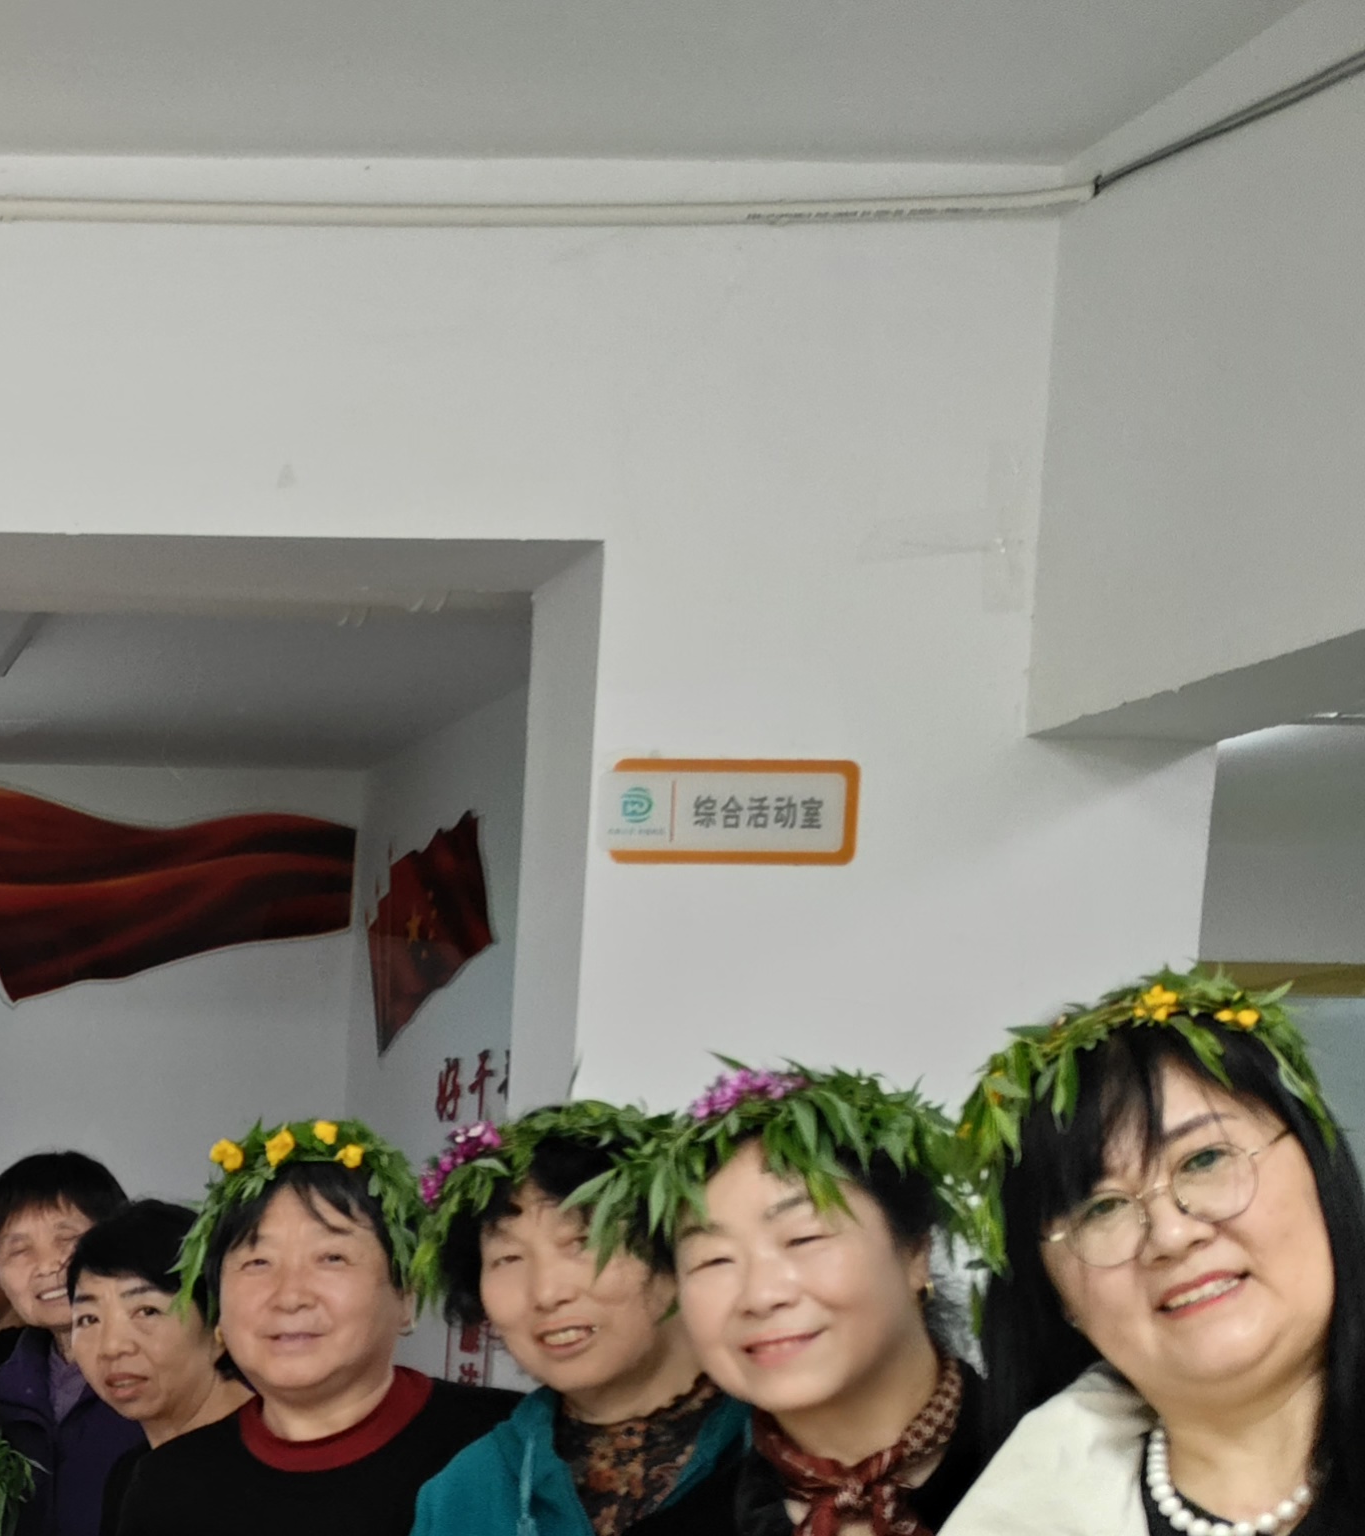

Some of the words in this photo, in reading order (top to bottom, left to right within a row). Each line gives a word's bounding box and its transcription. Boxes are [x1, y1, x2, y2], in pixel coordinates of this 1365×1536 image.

[693, 795, 824, 830] 综合活动室
